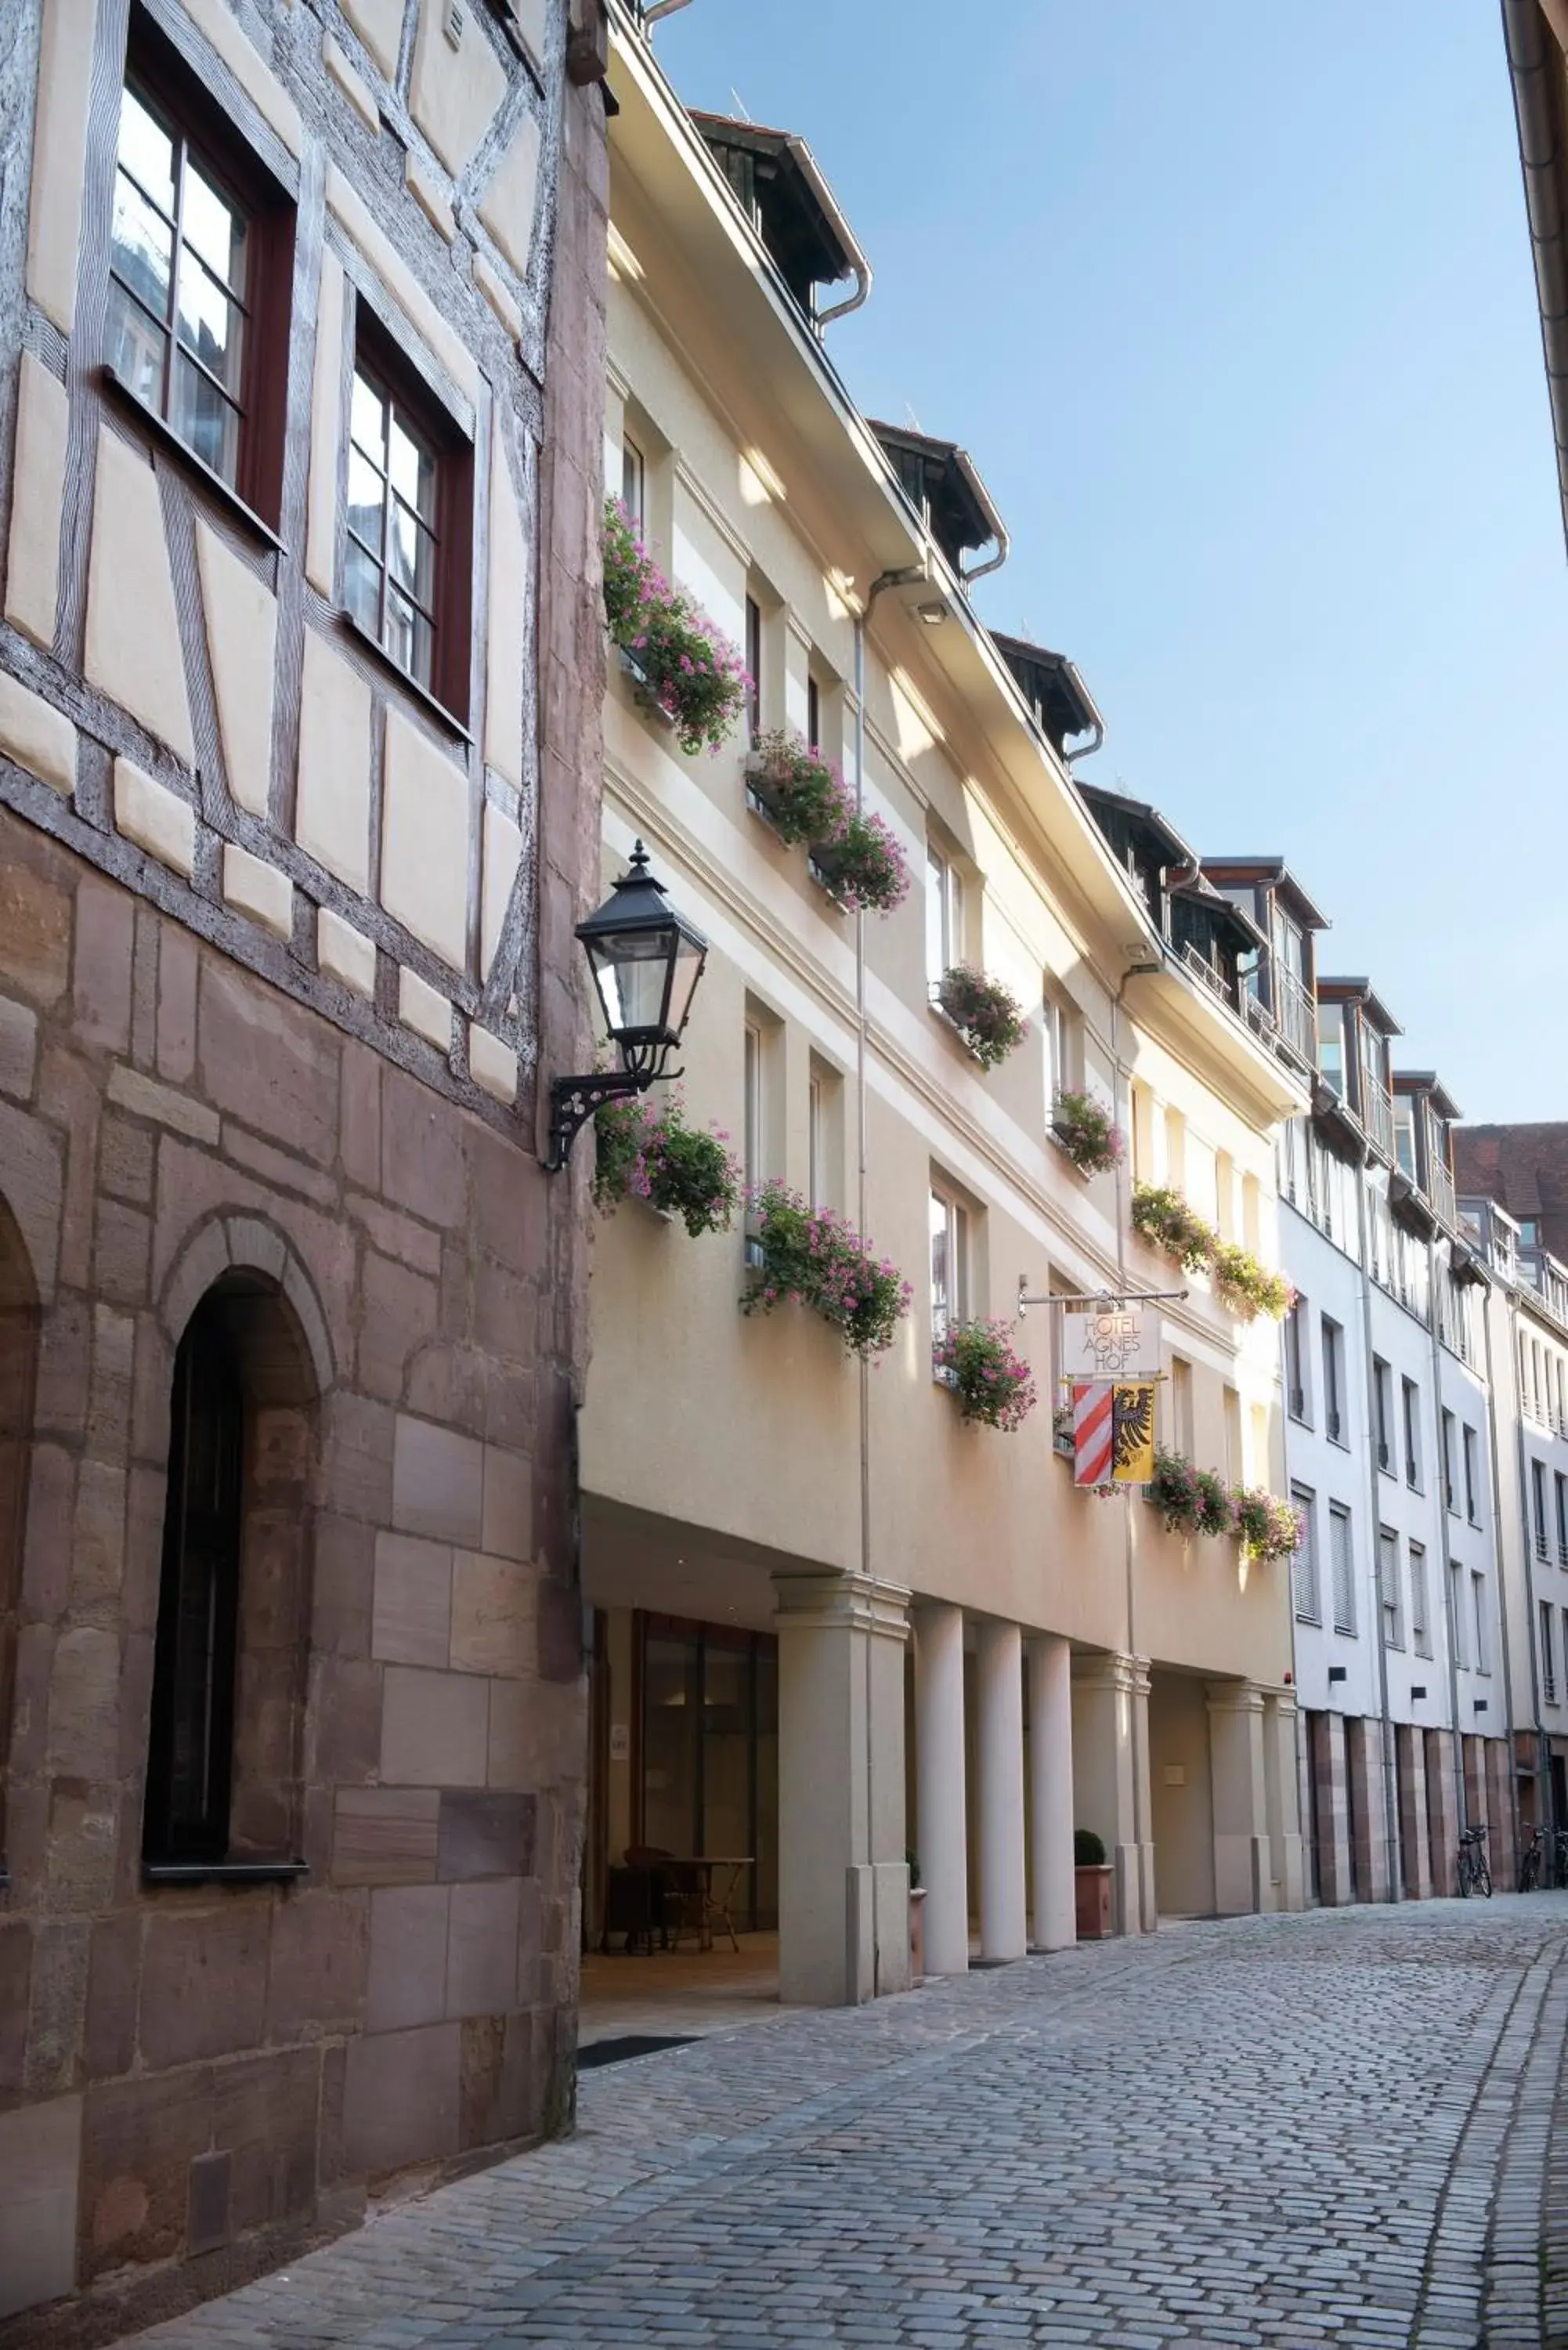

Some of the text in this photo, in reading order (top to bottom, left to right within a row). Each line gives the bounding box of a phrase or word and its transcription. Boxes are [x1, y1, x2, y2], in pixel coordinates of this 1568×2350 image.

[1084, 1316, 1141, 1336] HOTEL
[1082, 1336, 1141, 1354] AGNES
[1095, 1353, 1130, 1370] HOF
